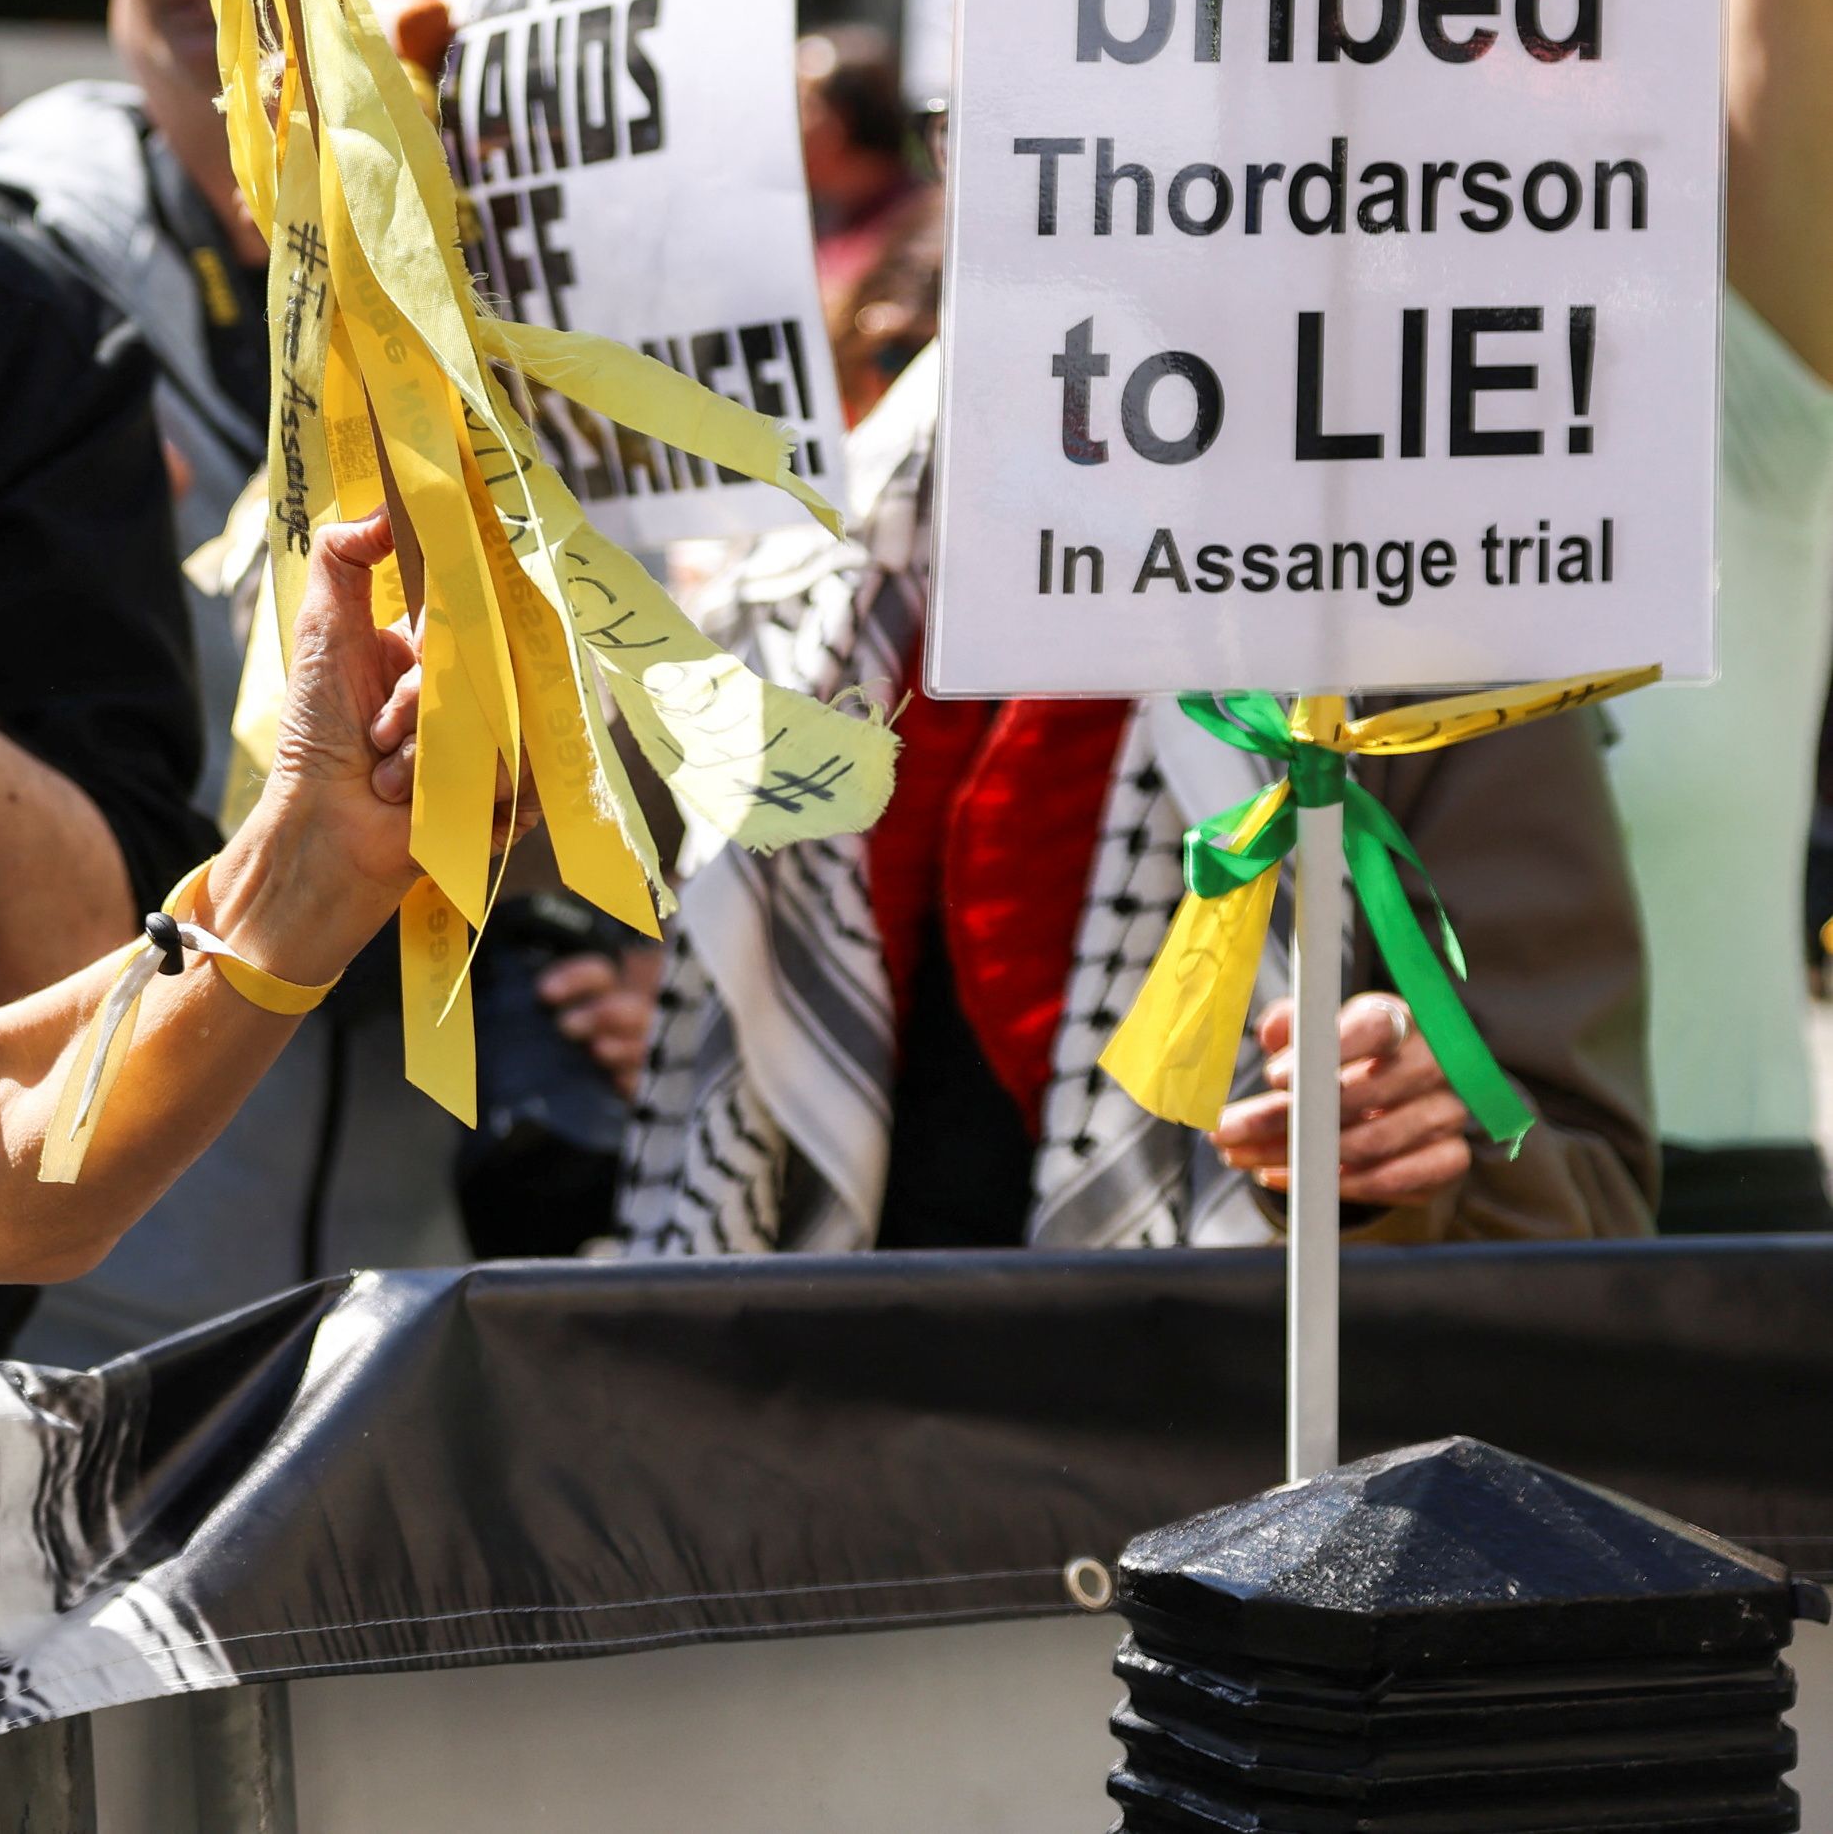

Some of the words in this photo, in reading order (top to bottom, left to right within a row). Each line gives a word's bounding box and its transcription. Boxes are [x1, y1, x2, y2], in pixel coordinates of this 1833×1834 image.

[1014, 137, 1647, 236] Thordarson
[1052, 317, 1225, 465] to
[1295, 306, 1596, 461] LIE!
[1039, 529, 1104, 594] In
[1132, 529, 1457, 607] Assange
[1481, 518, 1613, 586] trial
